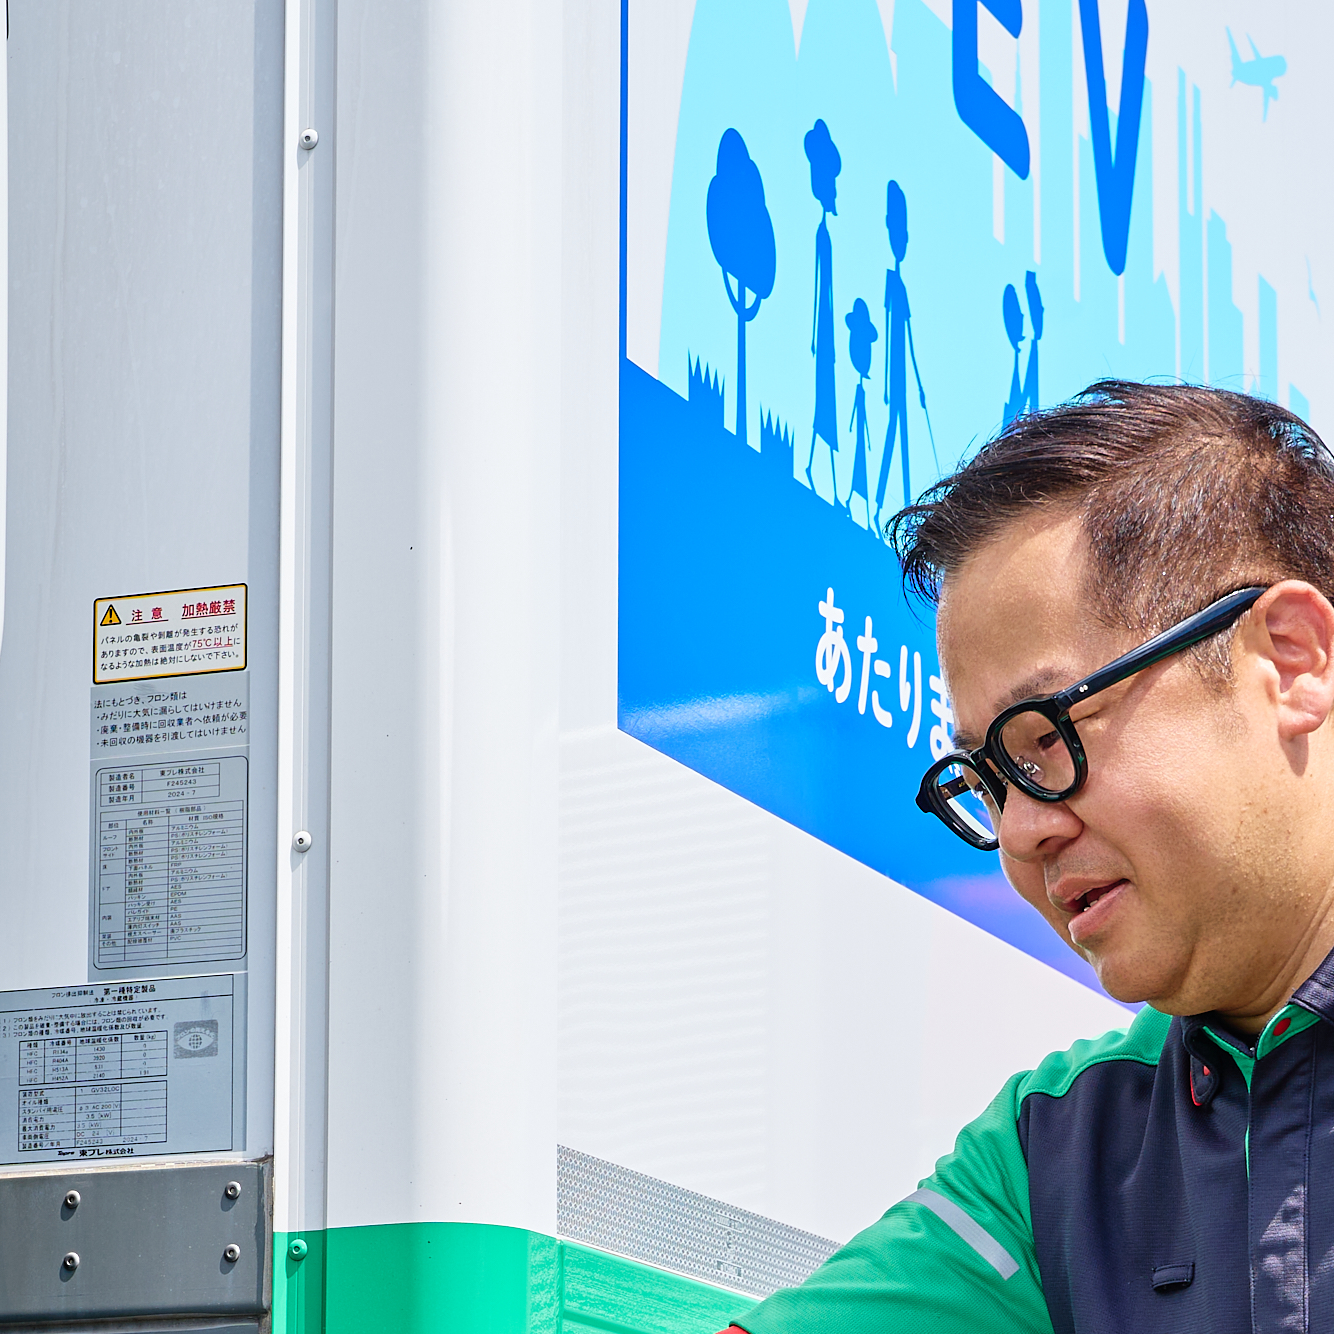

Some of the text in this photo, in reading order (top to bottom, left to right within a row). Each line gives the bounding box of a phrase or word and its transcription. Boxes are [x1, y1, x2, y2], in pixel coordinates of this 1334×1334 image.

[182, 599, 235, 617] 加熱厳禁
[101, 651, 239, 671] なるような加熱は絶対にしないで下さい。
[94, 691, 187, 709] 法にもとづき、フロン類は
[109, 767, 204, 781] 製造者名 東プレ株式会社
[109, 784, 134, 792] 製造番号
[109, 795, 134, 803] 製造年月
[104, 985, 156, 996] 第一種特定製品
[79, 1148, 134, 1156] 東プレ株式会社
